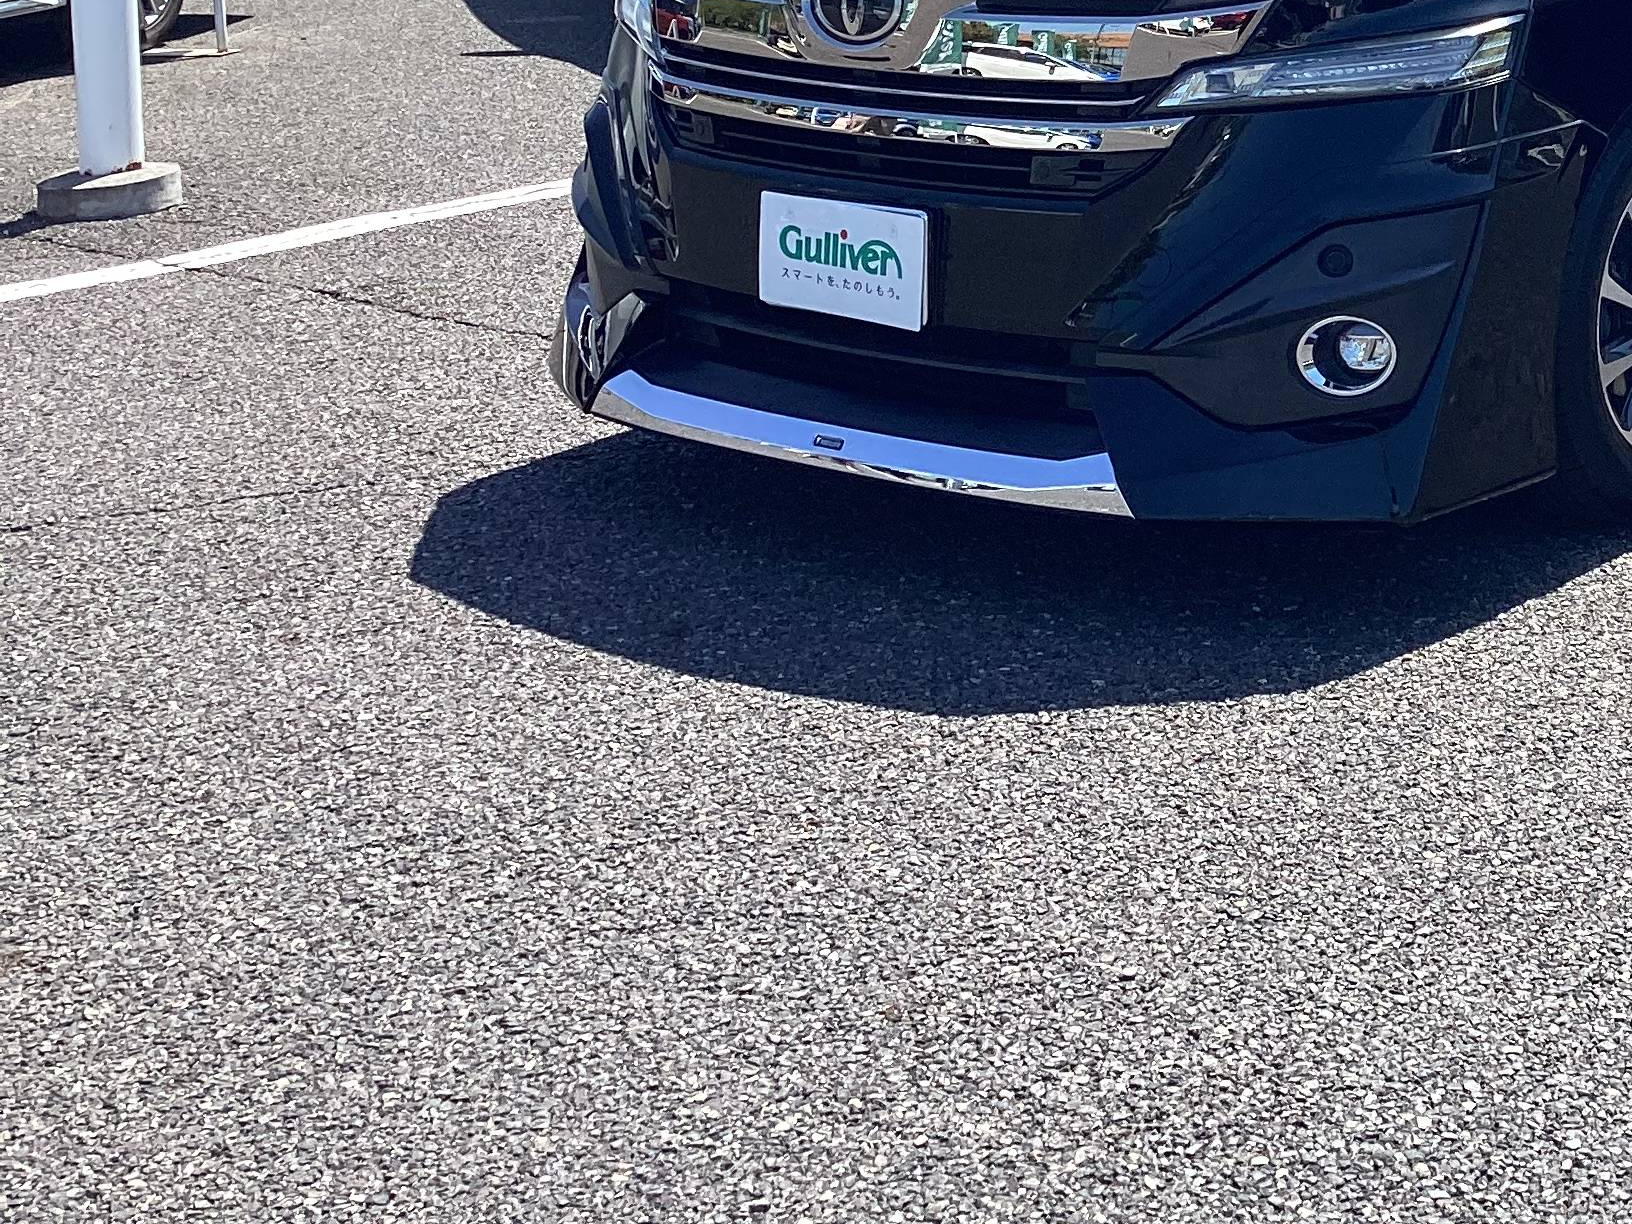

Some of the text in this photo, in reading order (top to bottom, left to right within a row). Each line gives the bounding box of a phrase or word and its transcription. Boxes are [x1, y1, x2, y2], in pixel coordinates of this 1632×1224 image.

[778, 224, 903, 280] Gulliver
[781, 267, 901, 300] スマートを、たのしもう。
